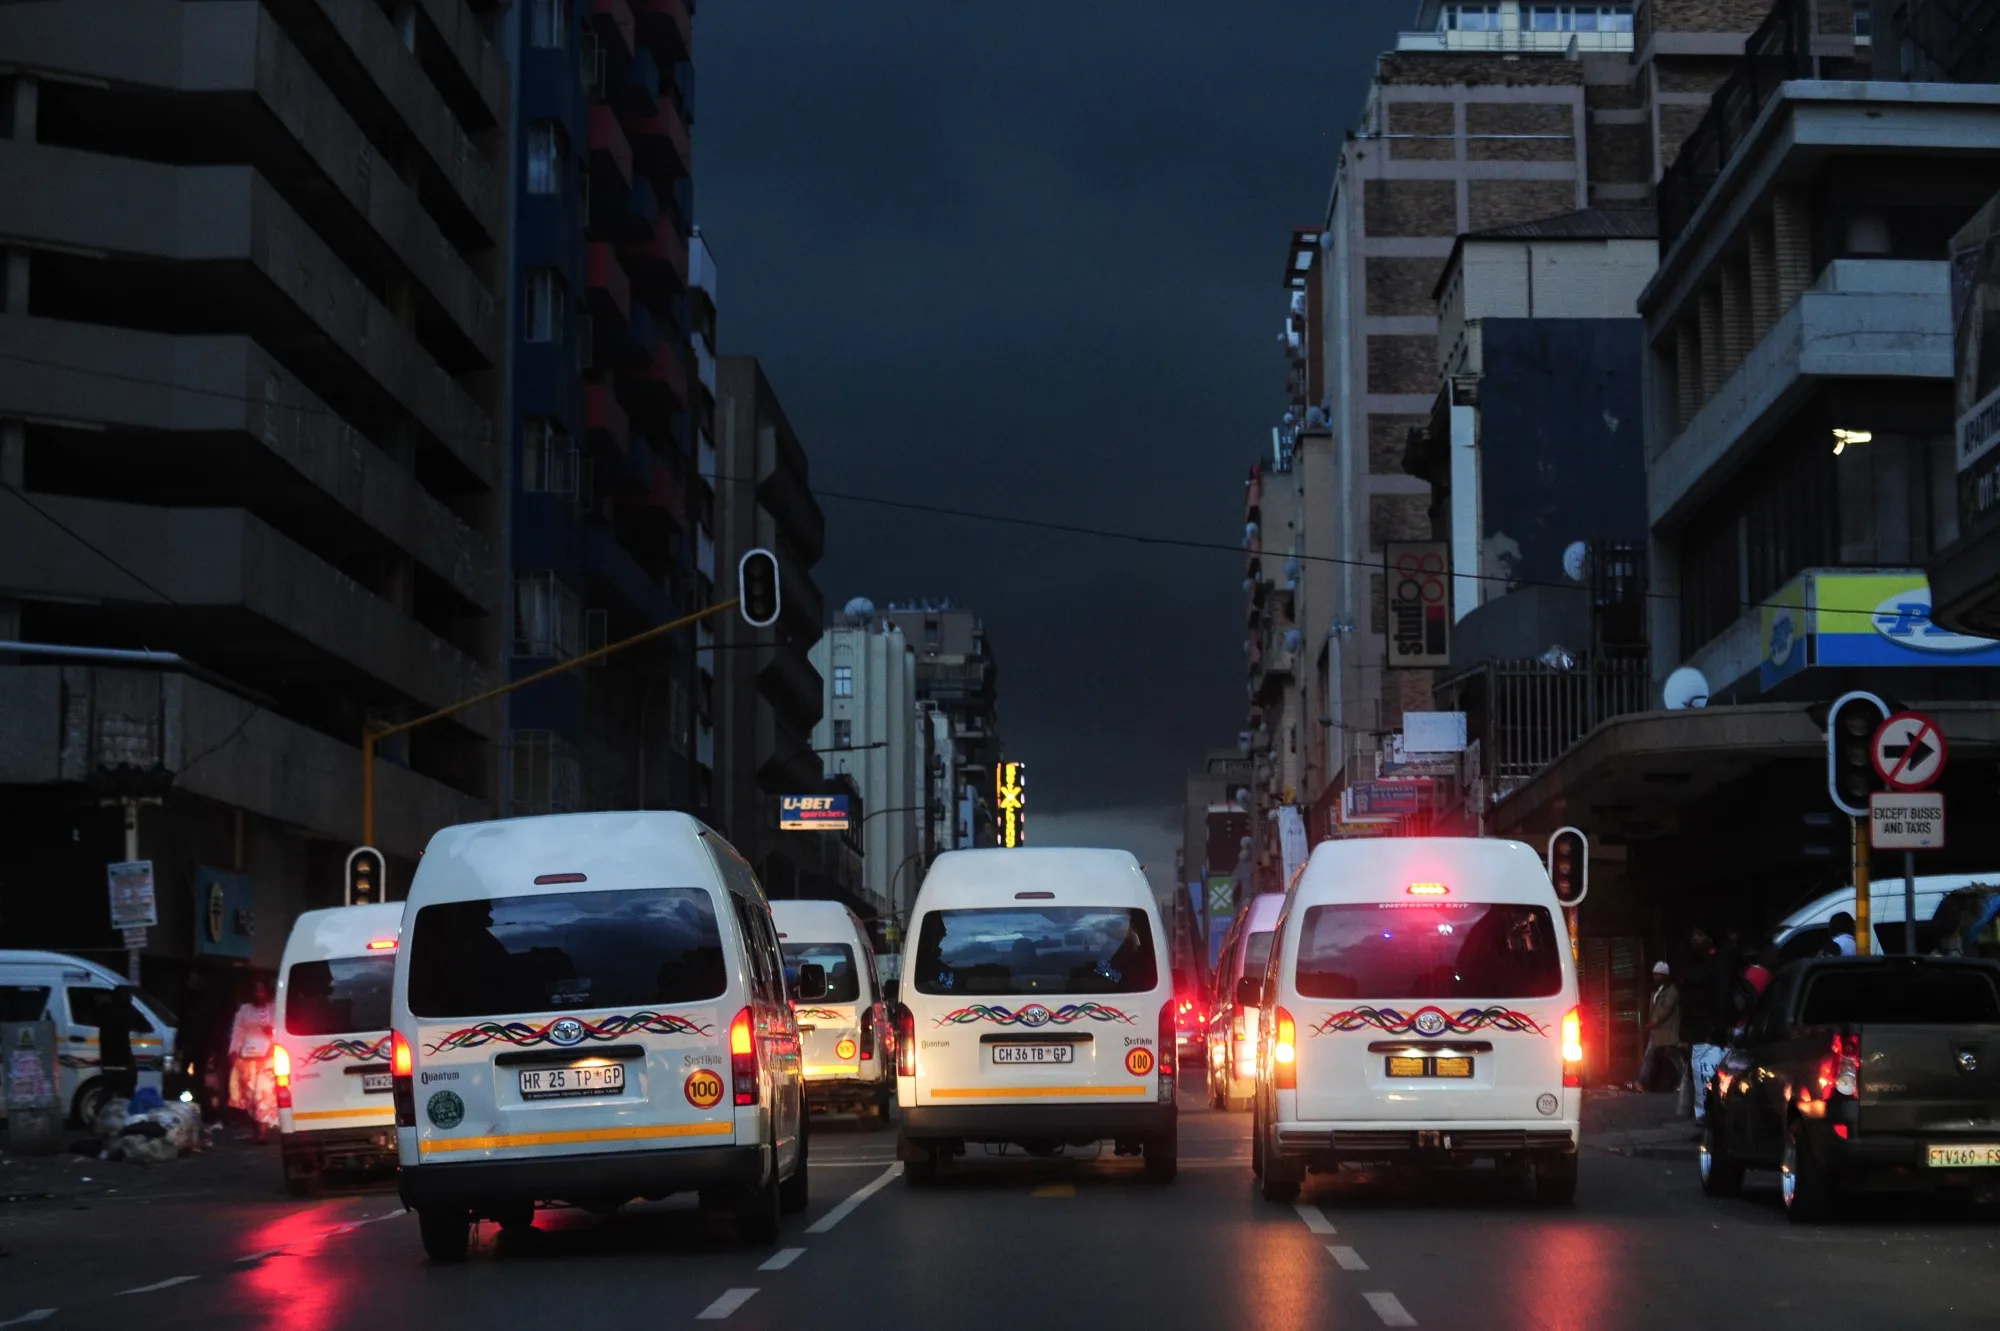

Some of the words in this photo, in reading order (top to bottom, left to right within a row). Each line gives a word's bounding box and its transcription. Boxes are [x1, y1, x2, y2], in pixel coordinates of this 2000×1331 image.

[783, 797, 835, 810] U-BET
[1874, 808, 1908, 820] EXCEPT
[1911, 808, 1942, 820] BUSES
[1884, 822, 1903, 834] AND
[1906, 822, 1932, 834] TAXIS
[921, 1040, 950, 1049] Quantum
[999, 1049, 1012, 1061] CH
[1015, 1048, 1028, 1060] 36
[1030, 1048, 1044, 1060] TB
[1053, 1048, 1067, 1061] GP
[1132, 1054, 1148, 1069] 100
[421, 1071, 460, 1085] Quantum
[523, 1073, 541, 1089] HR
[549, 1071, 565, 1088] 25
[575, 1070, 591, 1086] TP
[604, 1067, 621, 1084] GP
[690, 1080, 719, 1098] 100
[1930, 1149, 1976, 1164] FTV169
